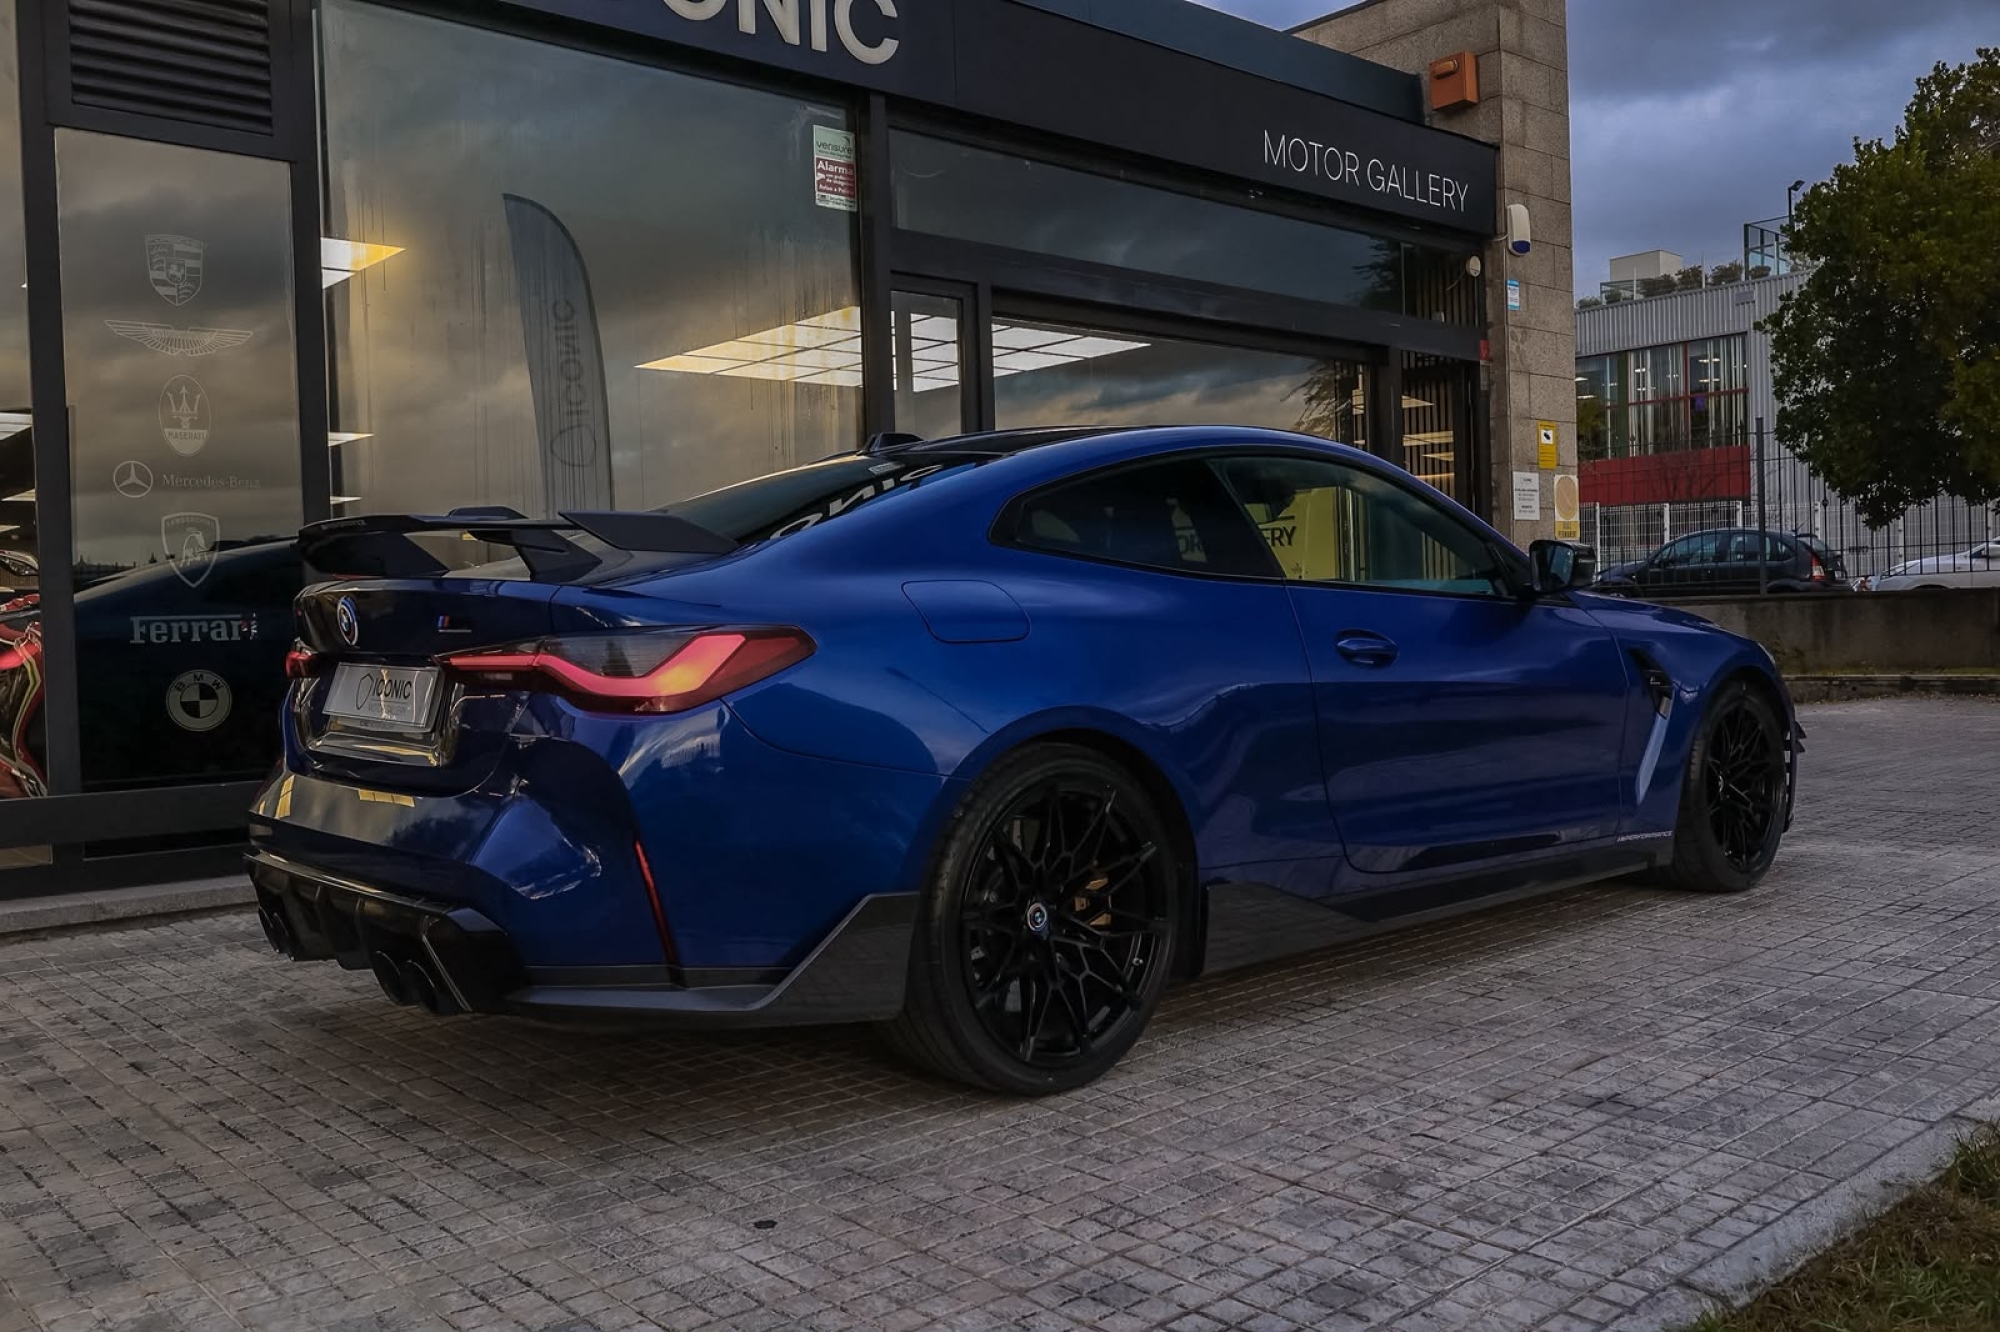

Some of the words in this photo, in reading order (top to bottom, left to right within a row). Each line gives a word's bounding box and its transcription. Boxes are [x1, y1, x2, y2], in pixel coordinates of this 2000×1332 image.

[663, 0, 899, 65] NIC
[817, 160, 854, 175] Alarma
[1263, 129, 1360, 187] MOTOR
[1367, 158, 1469, 212] GALLERY
[162, 474, 260, 488] Mercedes-Benz
[371, 677, 412, 700] ICONIC
